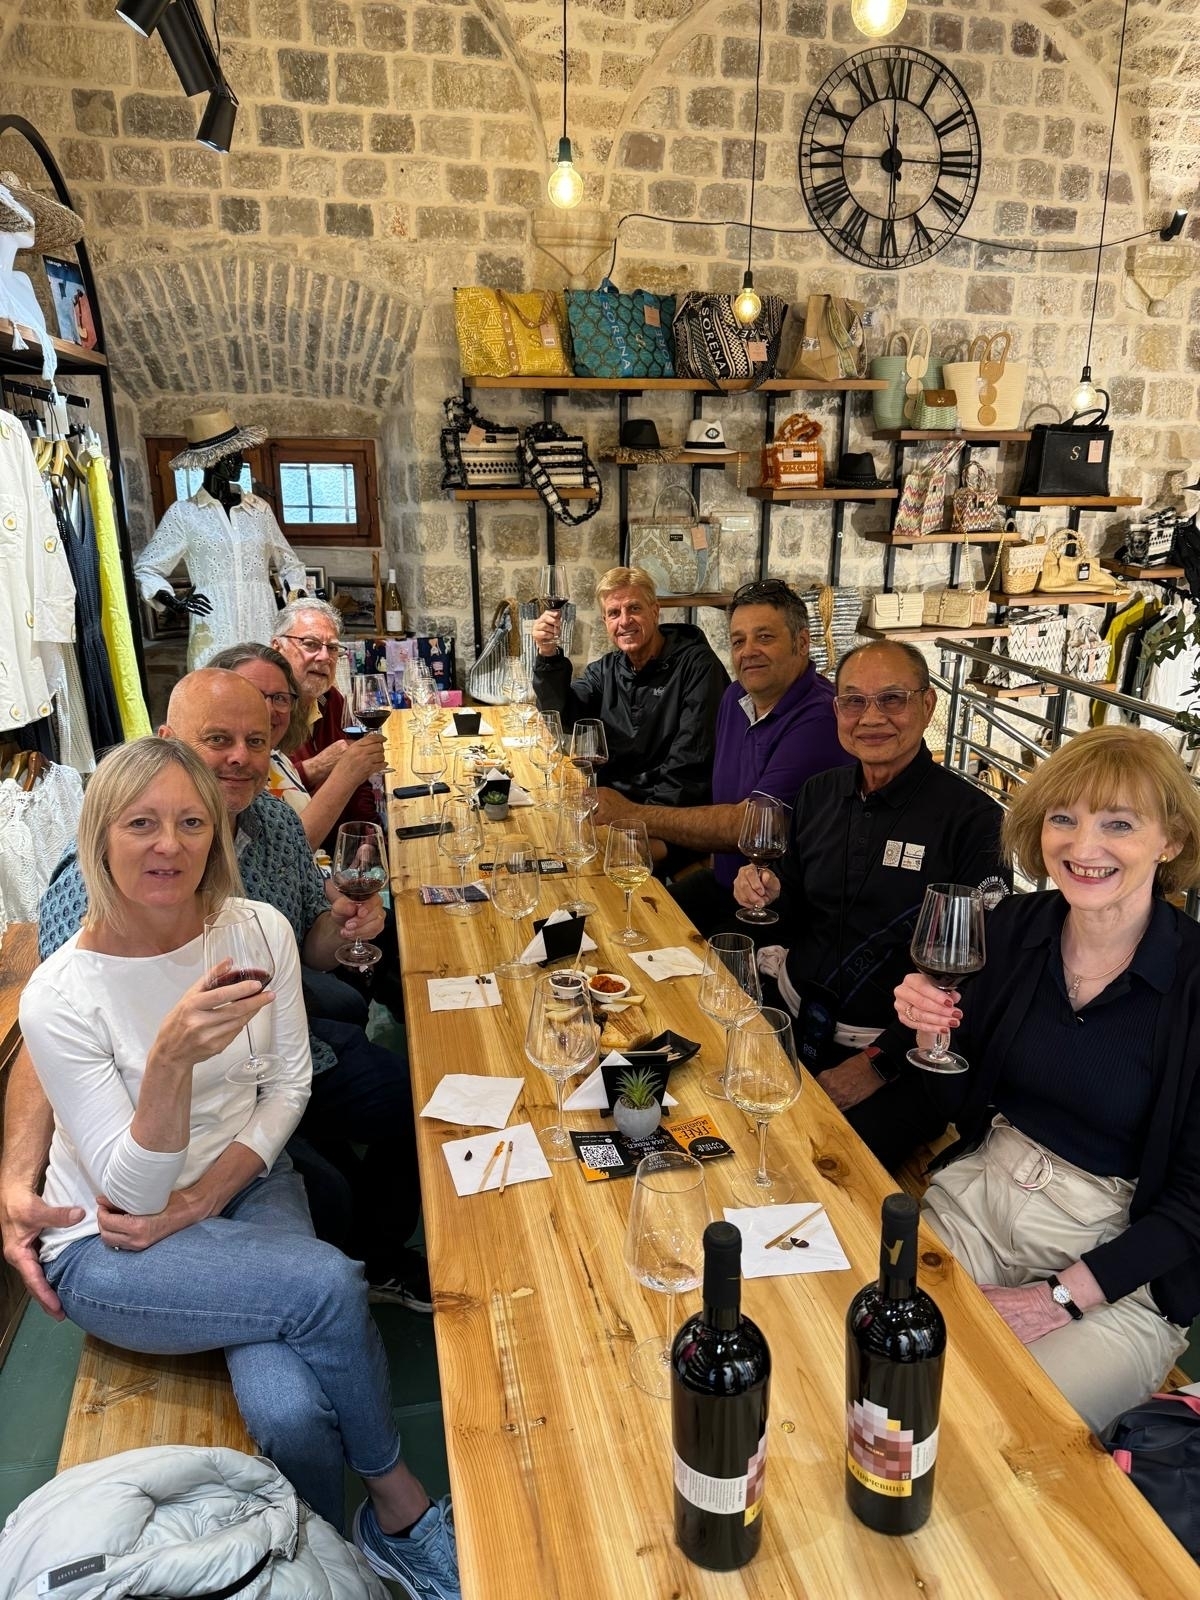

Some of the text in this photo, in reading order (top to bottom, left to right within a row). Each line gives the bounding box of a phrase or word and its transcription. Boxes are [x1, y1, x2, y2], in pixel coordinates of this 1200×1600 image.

[847, 62, 879, 110] XI
[886, 57, 914, 100] XII
[919, 73, 941, 110] I
[821, 98, 856, 133] X
[935, 108, 968, 139] II
[810, 138, 844, 170] IX
[940, 150, 972, 179] III
[839, 206, 868, 250] VII
[879, 219, 899, 258] VI
[912, 213, 934, 251] V
[602, 301, 631, 370] SORENA
[701, 306, 727, 370] SORENA
[1070, 445, 1081, 461] S
[679, 1125, 710, 1140] FREE
